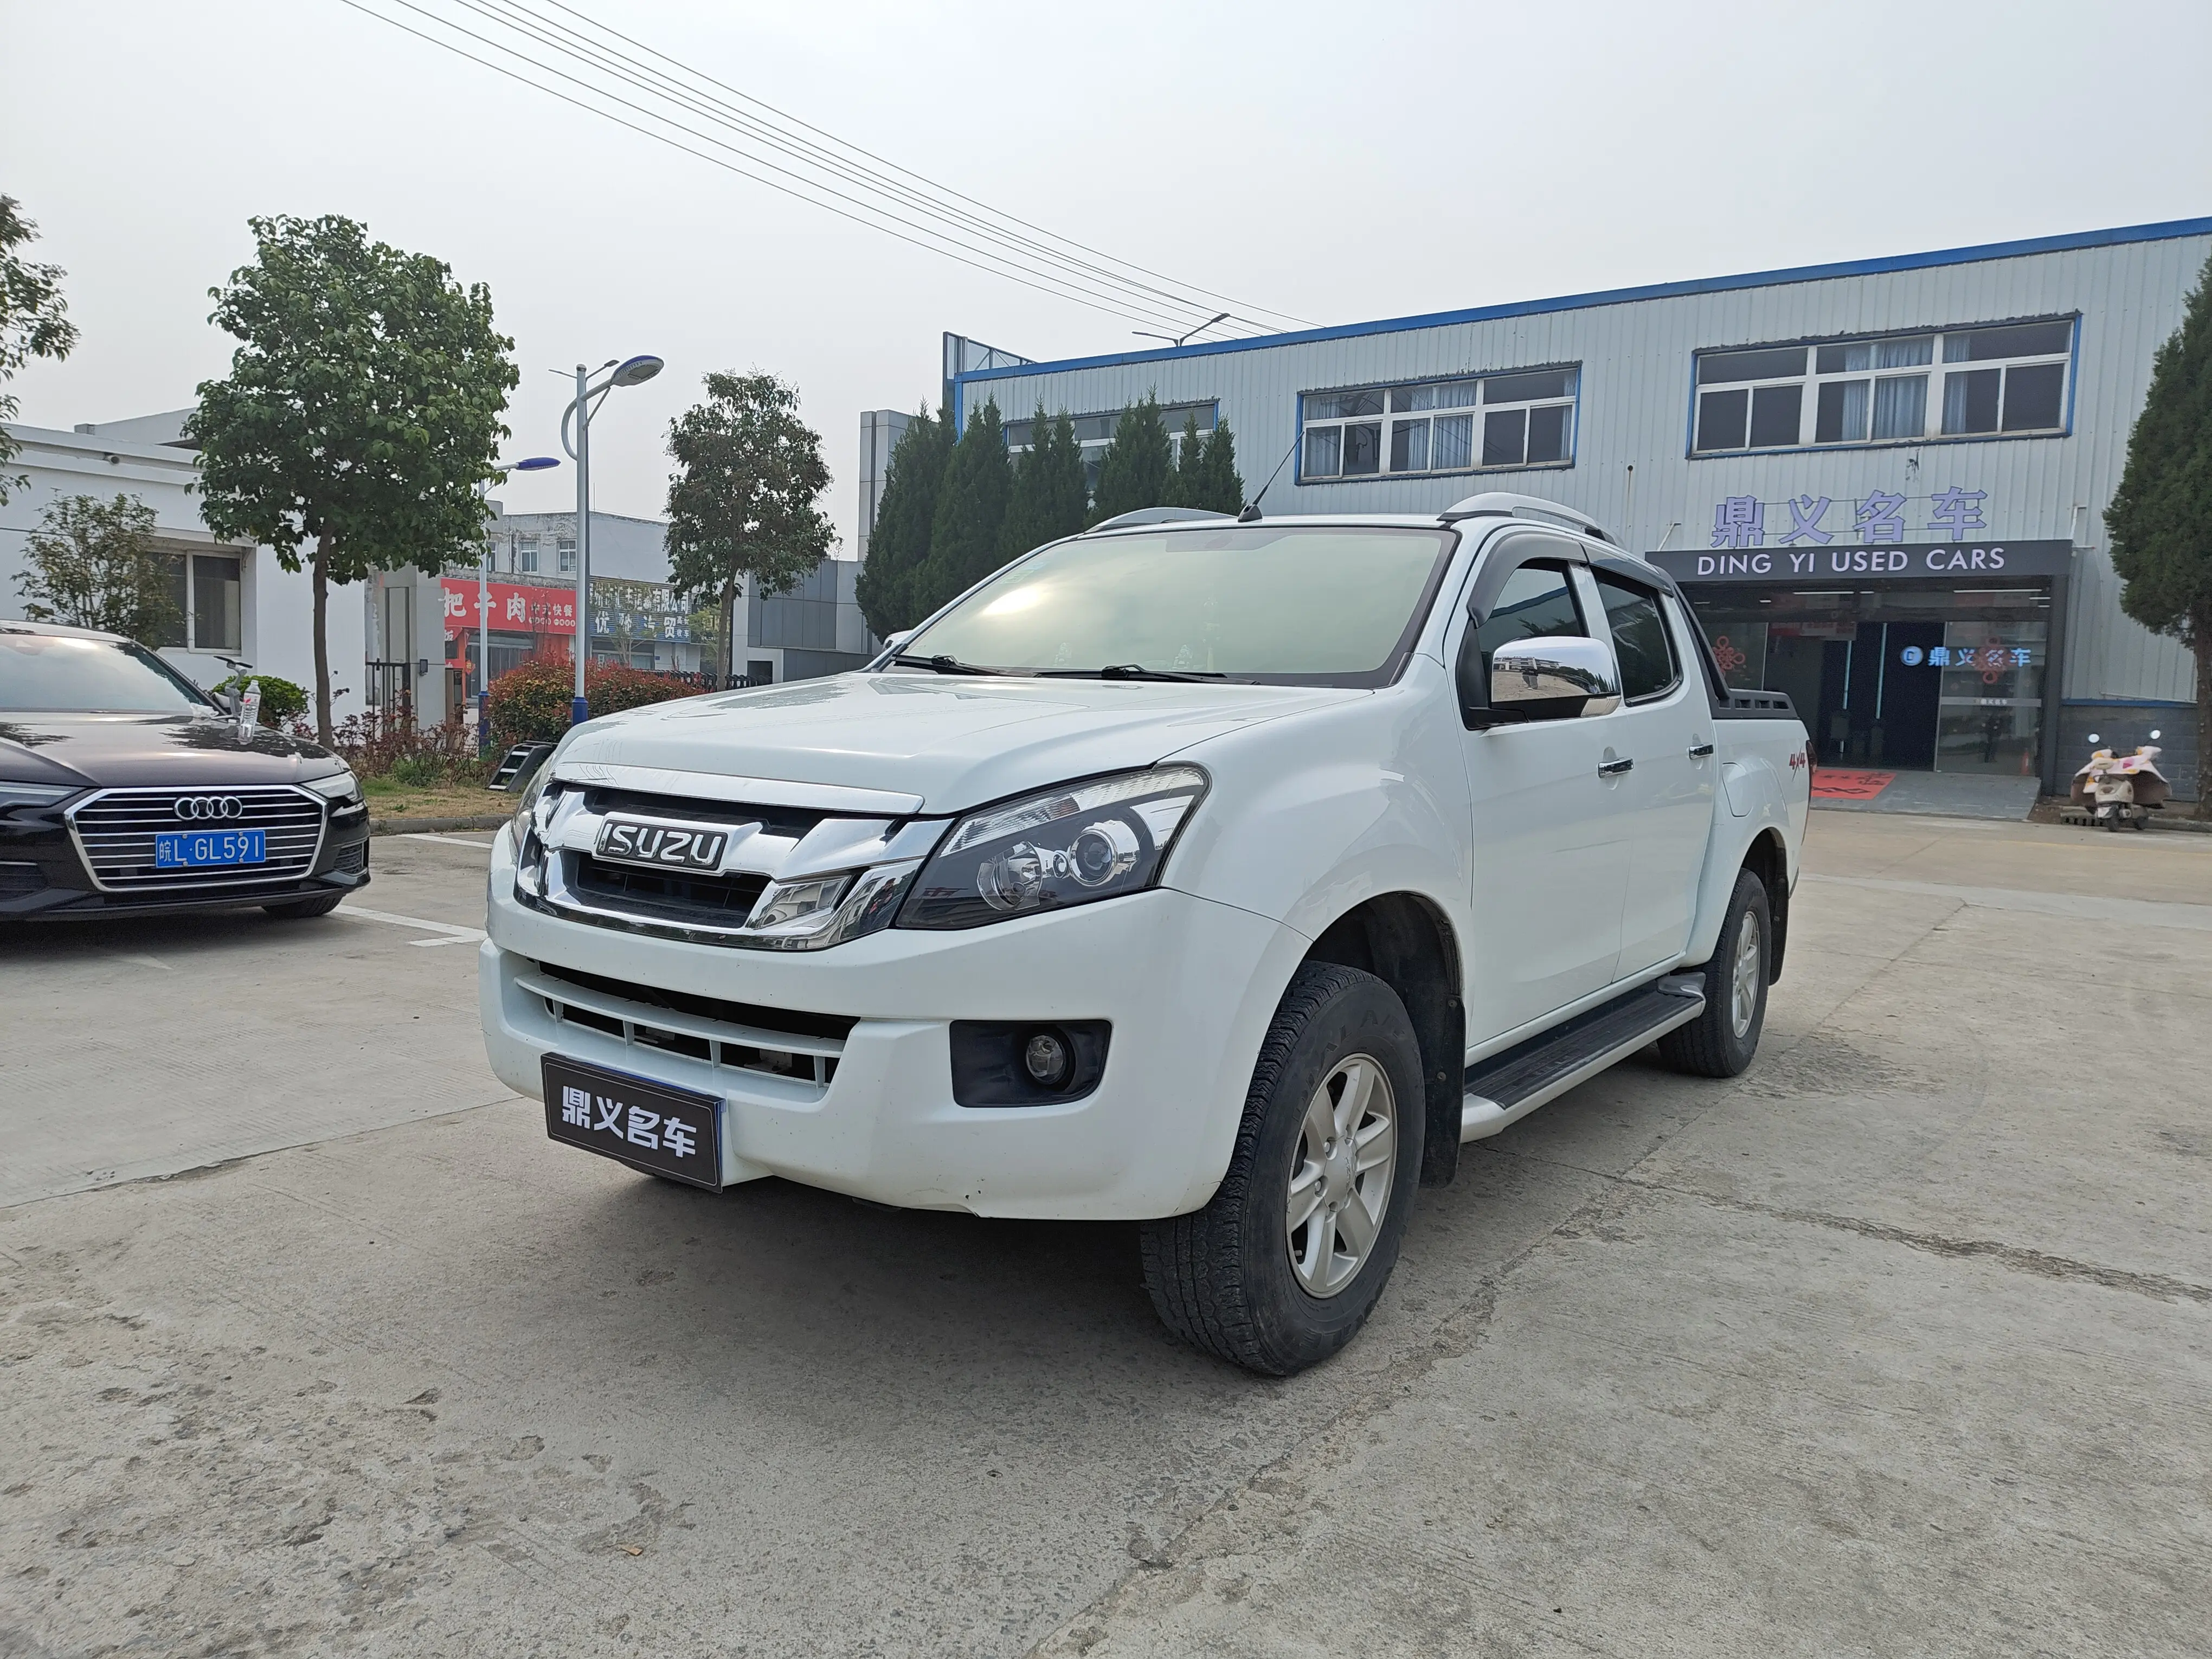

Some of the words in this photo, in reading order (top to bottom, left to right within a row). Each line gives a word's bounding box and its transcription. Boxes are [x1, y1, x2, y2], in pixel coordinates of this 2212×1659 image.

[1711, 486, 1988, 548] 鼎义名车
[1697, 554, 1772, 575] DING
[1790, 553, 1815, 573] YI
[1831, 550, 1908, 573] USED
[1926, 548, 2005, 570] CARS
[1928, 646, 2031, 667] 鼎义名车
[598, 824, 722, 866] ISUZU
[562, 1085, 697, 1158] 鼎义名车
